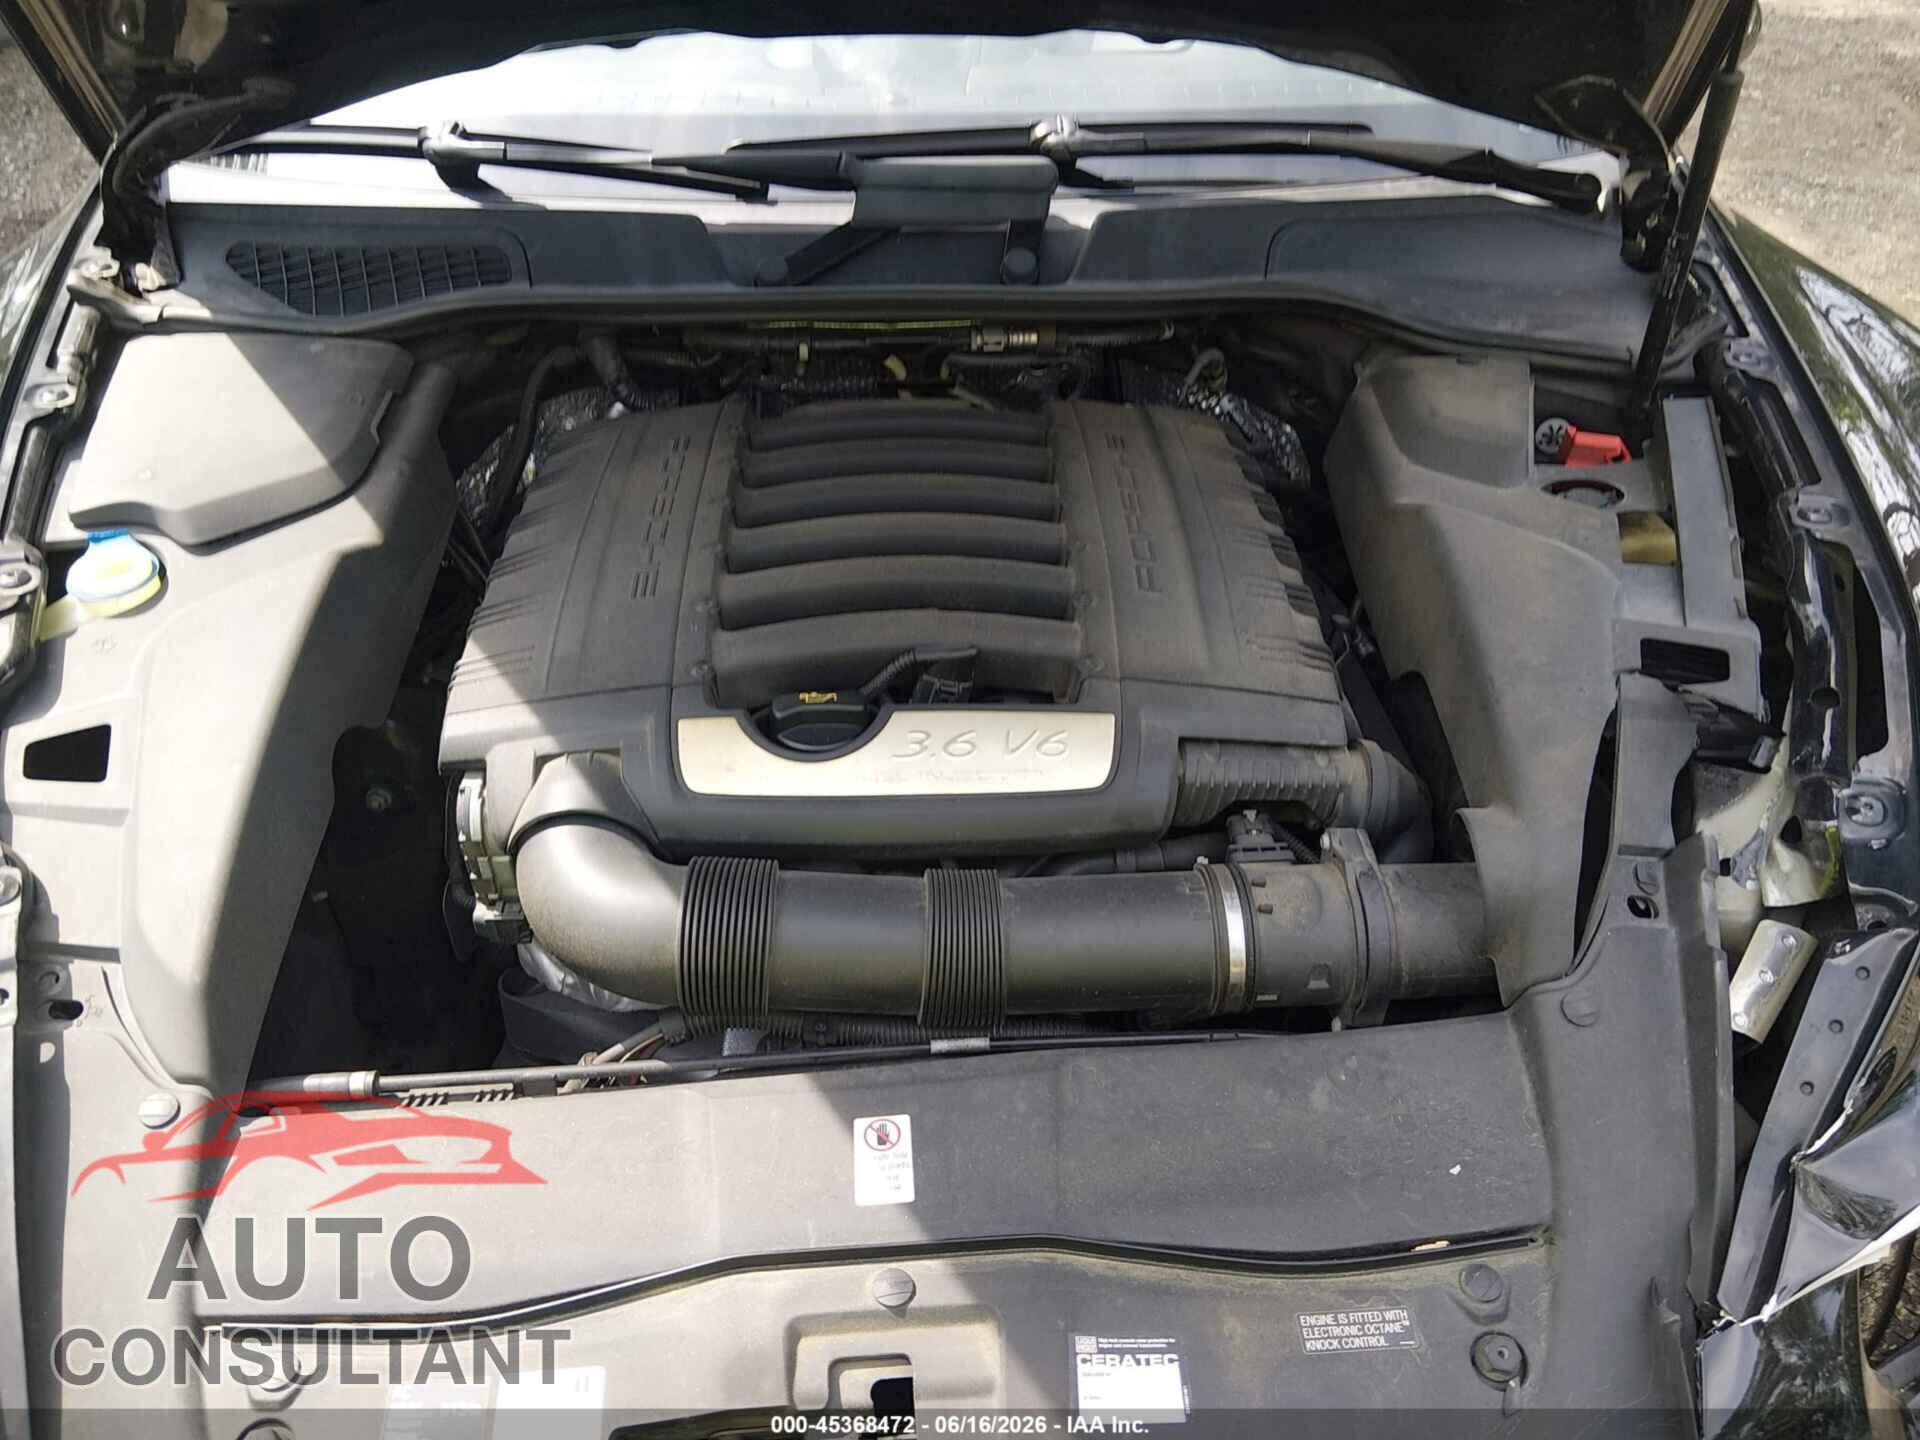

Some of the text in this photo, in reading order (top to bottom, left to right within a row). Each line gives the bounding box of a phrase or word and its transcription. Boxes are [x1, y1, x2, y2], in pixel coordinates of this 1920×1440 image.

[892, 728, 1069, 758] 3.6 V6
[1299, 1309, 1408, 1327] ENGINE IS FITTED WITH
[1302, 1324, 1362, 1339] ELECTRONIC
[1305, 1335, 1389, 1351] KNOCK CONTROL
[1076, 1353, 1180, 1367] CERATEC
